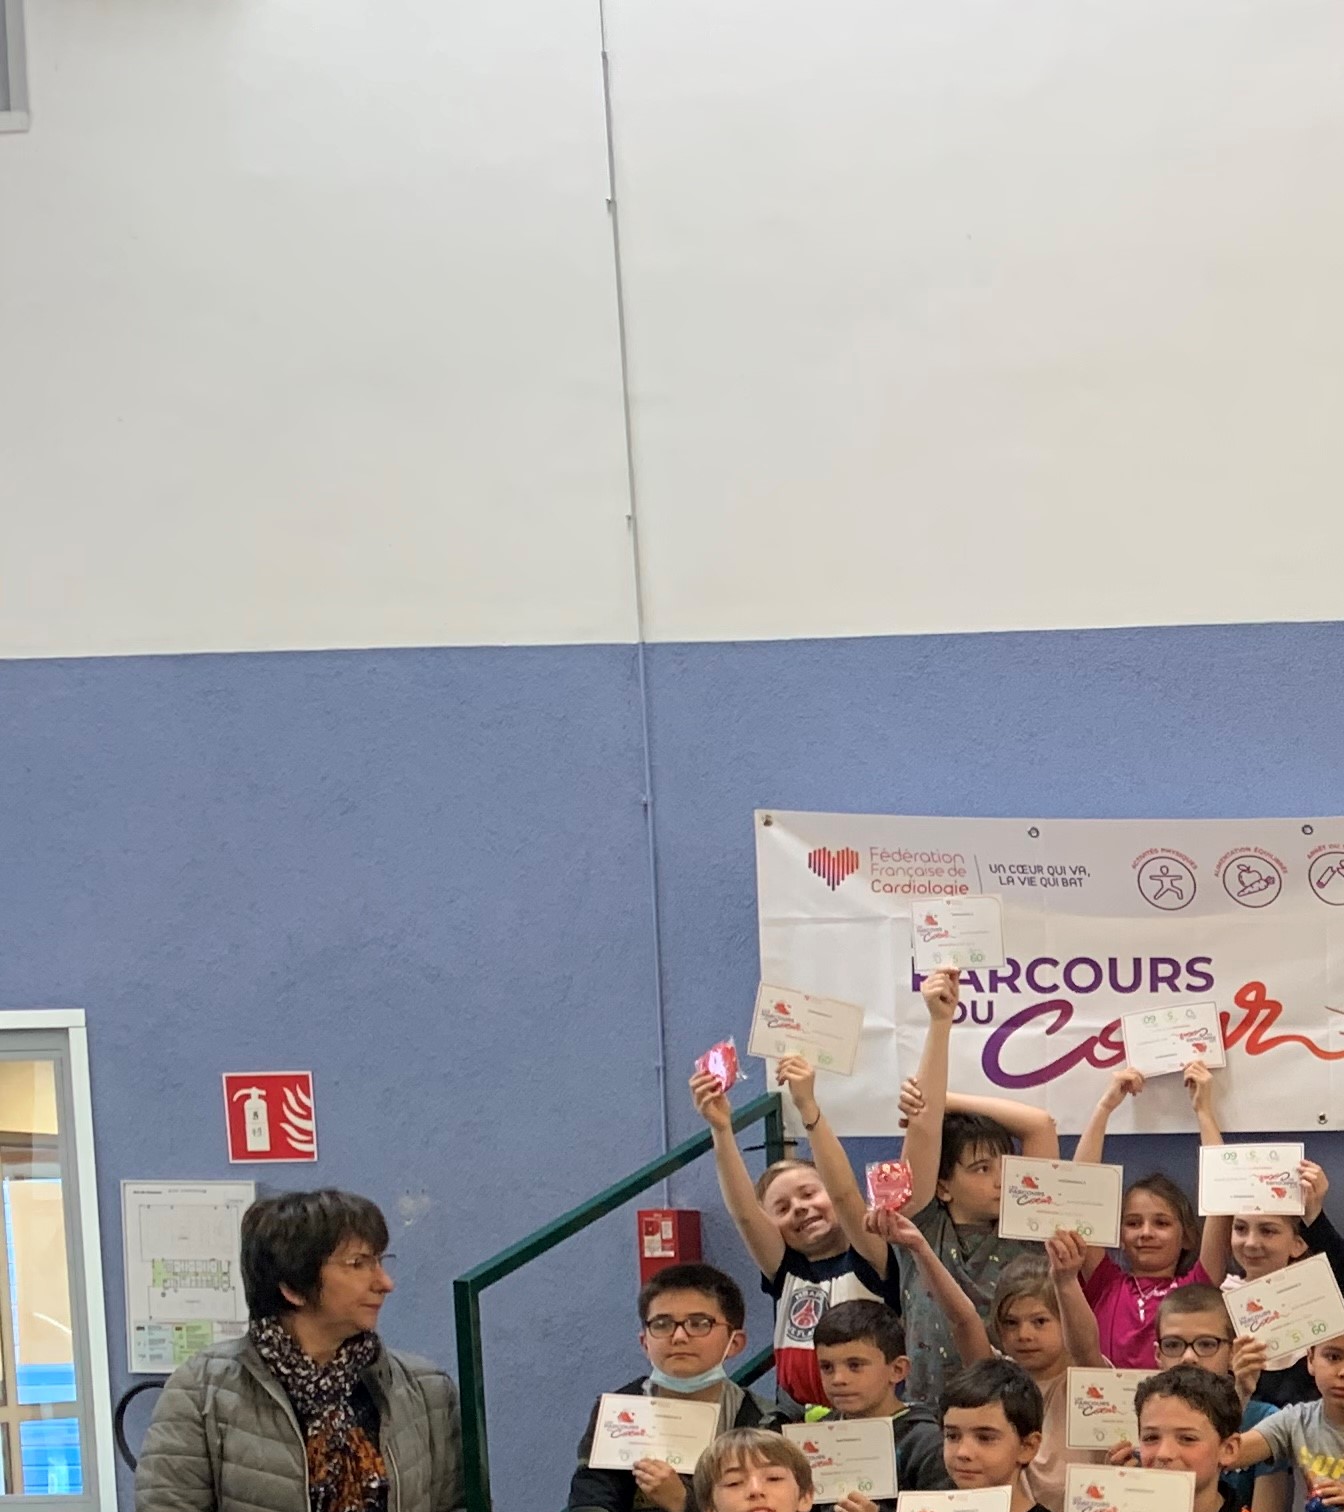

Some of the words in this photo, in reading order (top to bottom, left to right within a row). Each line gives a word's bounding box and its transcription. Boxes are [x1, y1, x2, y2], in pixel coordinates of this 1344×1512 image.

[869, 847, 965, 864] Fédération
[871, 864, 944, 880] Française
[946, 865, 966, 877] de
[989, 864, 1006, 875] UN
[1047, 865, 1068, 877] QUI
[871, 879, 969, 896] Cardiologie
[999, 876, 1016, 886] LA
[1018, 876, 1037, 887] VIE
[1040, 877, 1060, 888] QUI
[1062, 878, 1084, 888] BAT
[1311, 1322, 1326, 1335] 60
[666, 1454, 682, 1466] 60
[858, 1480, 872, 1491] 60
